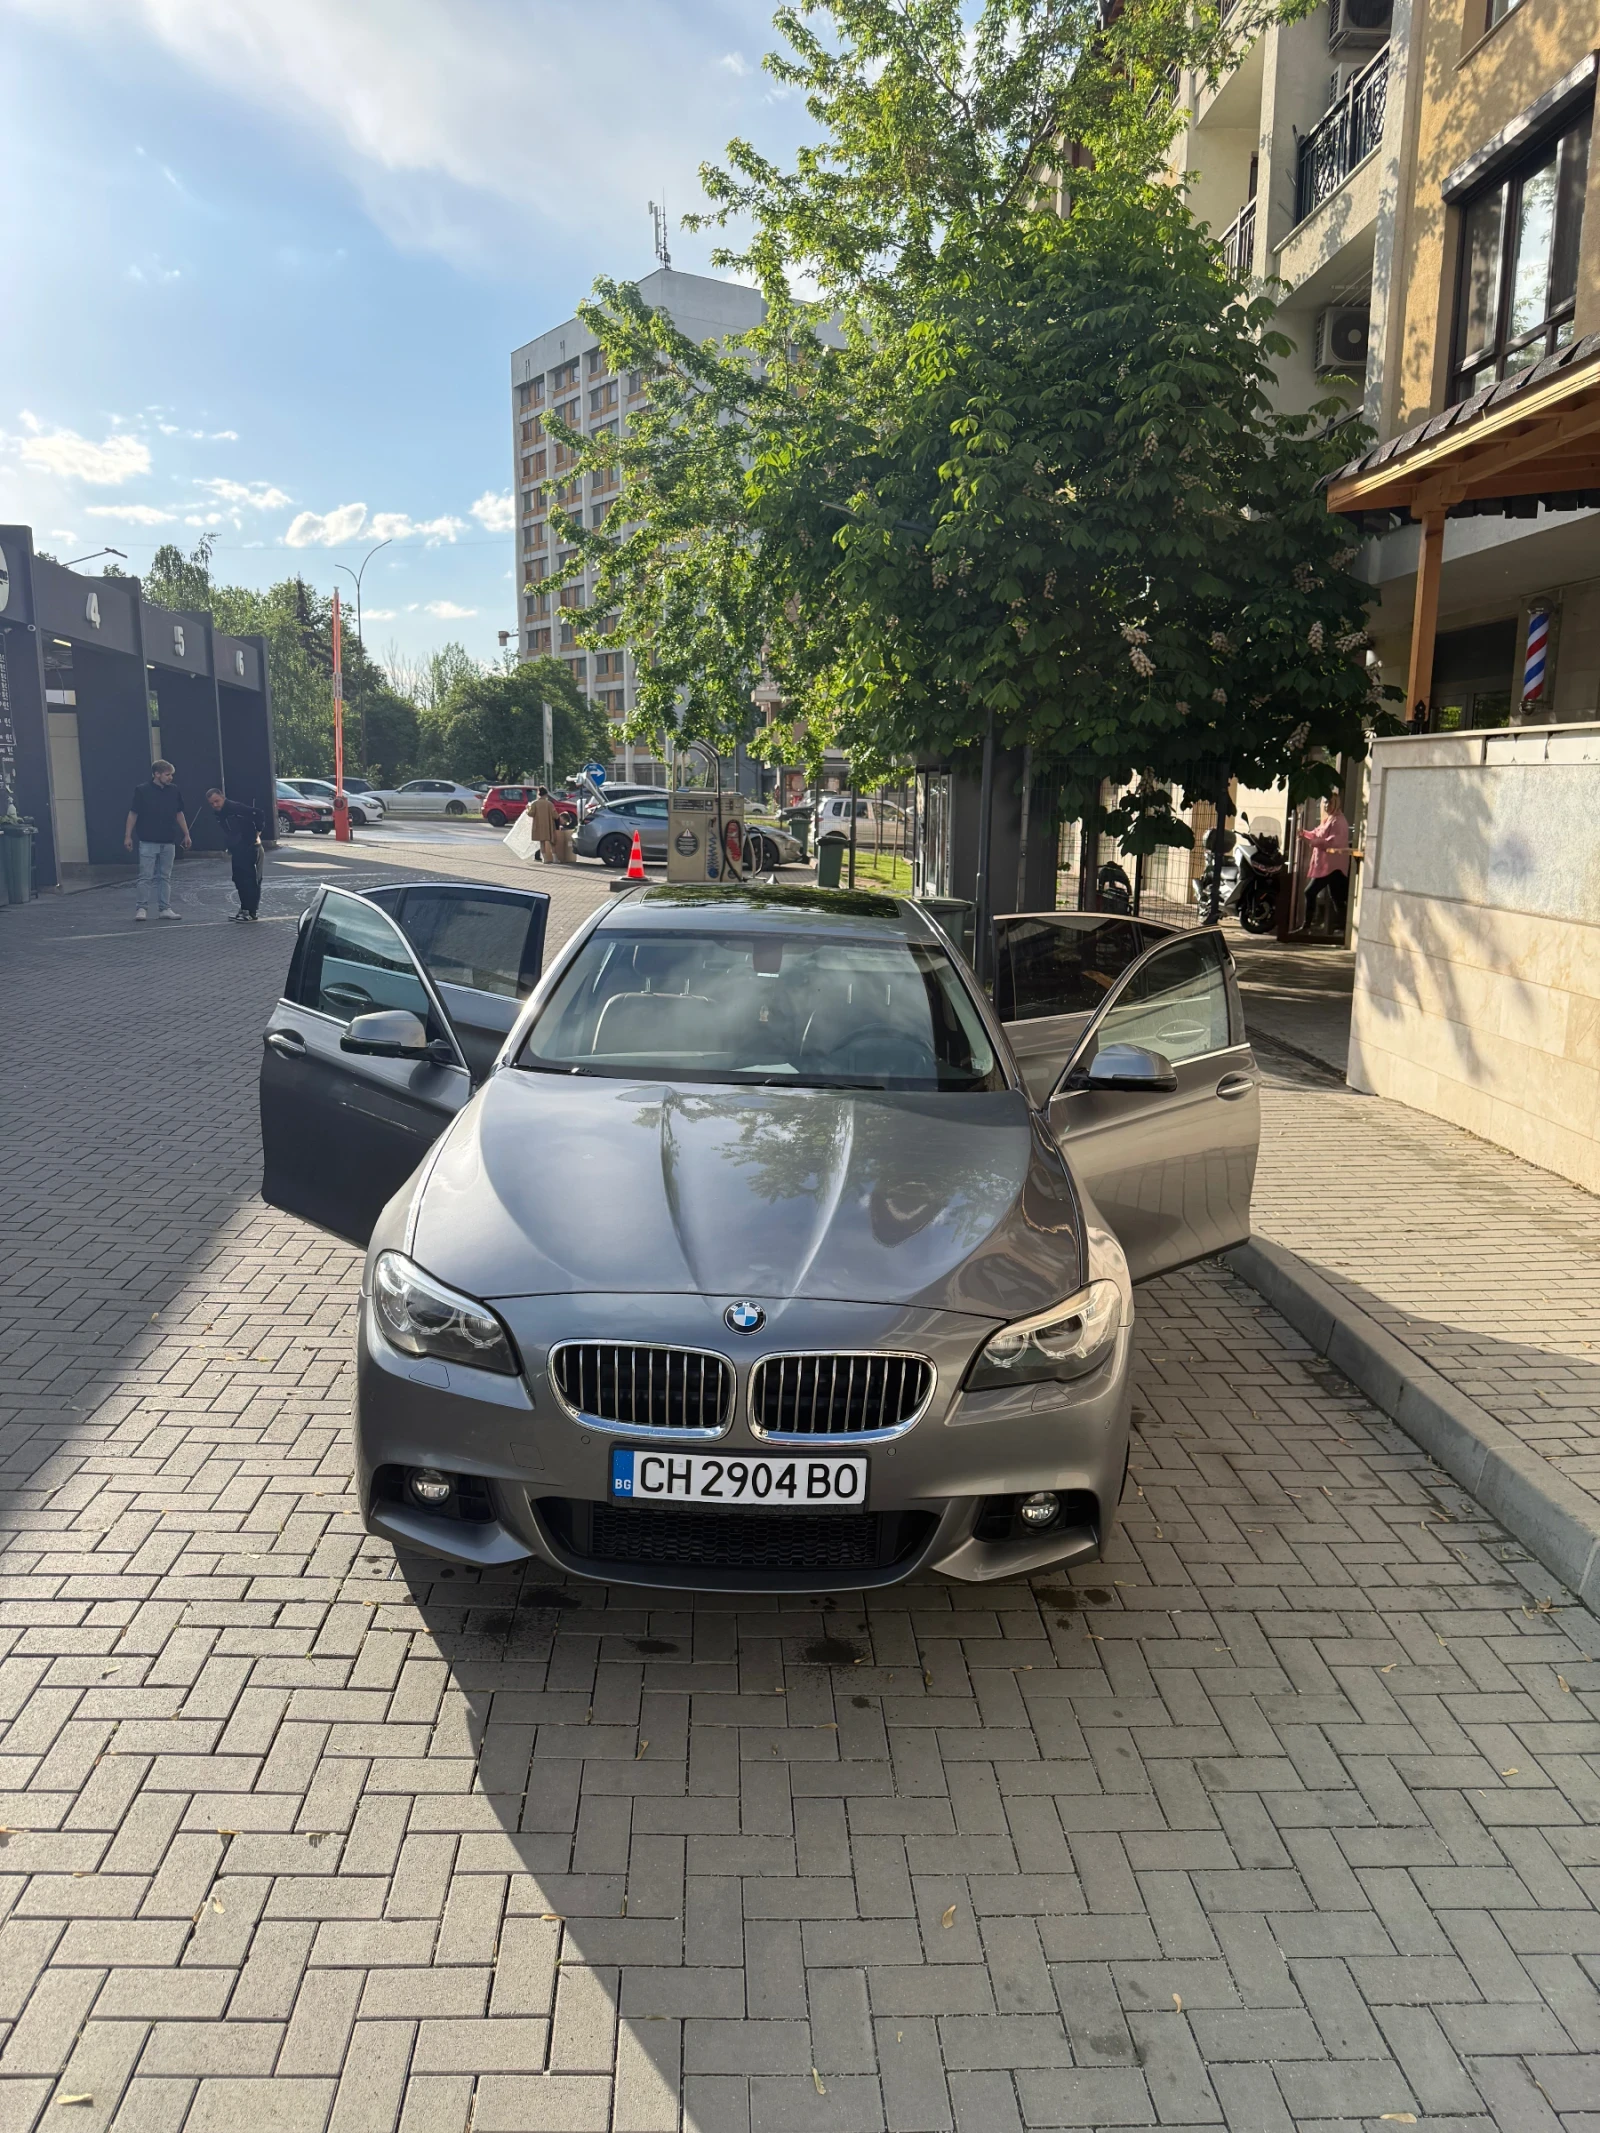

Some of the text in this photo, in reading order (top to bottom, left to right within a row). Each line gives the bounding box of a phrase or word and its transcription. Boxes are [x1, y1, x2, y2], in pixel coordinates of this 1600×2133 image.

[86, 592, 101, 630] 4
[173, 625, 185, 657] 5
[235, 650, 245, 676] 6
[730, 1302, 763, 1312] BMW
[614, 1478, 632, 1491] BG
